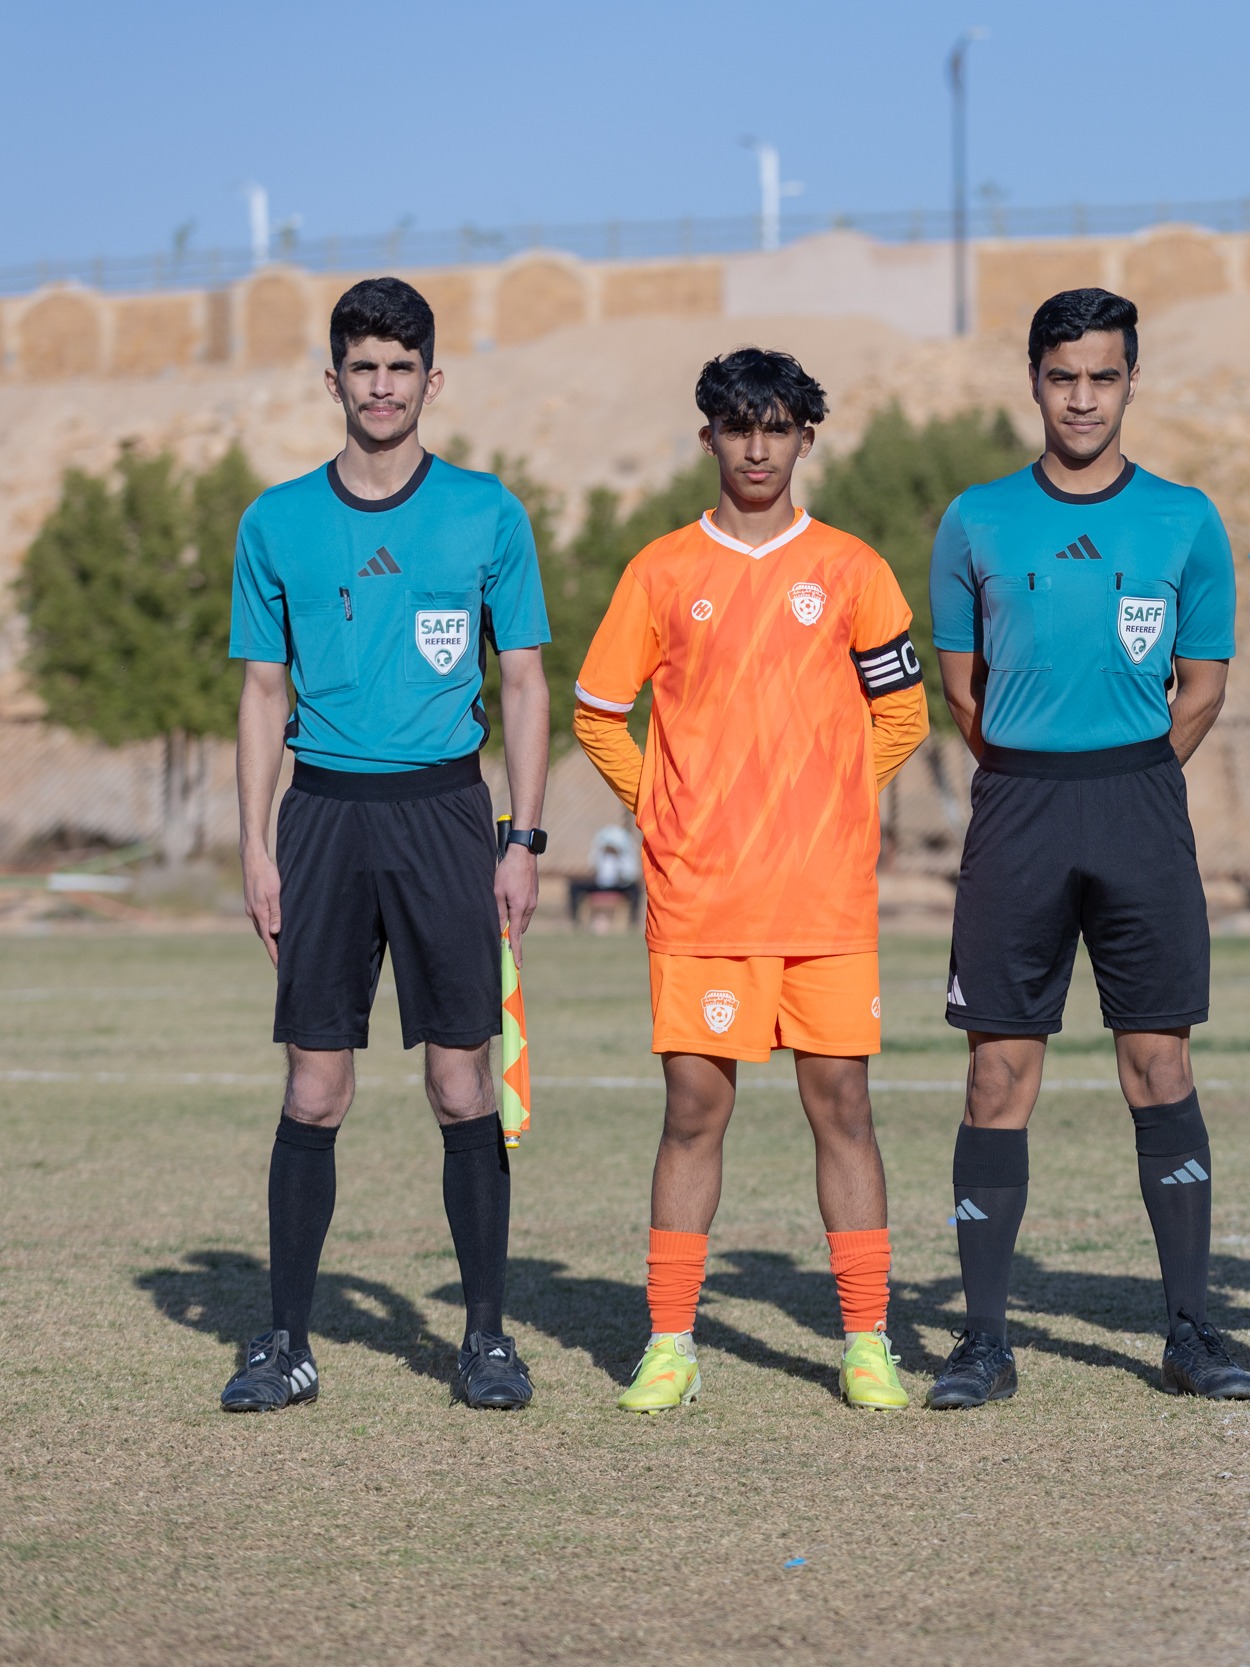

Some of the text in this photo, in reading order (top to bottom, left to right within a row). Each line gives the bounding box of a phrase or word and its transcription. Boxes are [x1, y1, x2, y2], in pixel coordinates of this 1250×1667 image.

[1124, 606, 1162, 622] SAFF
[421, 618, 465, 635] SAFF
[1126, 625, 1156, 633] REFEREE
[901, 640, 920, 675] C
